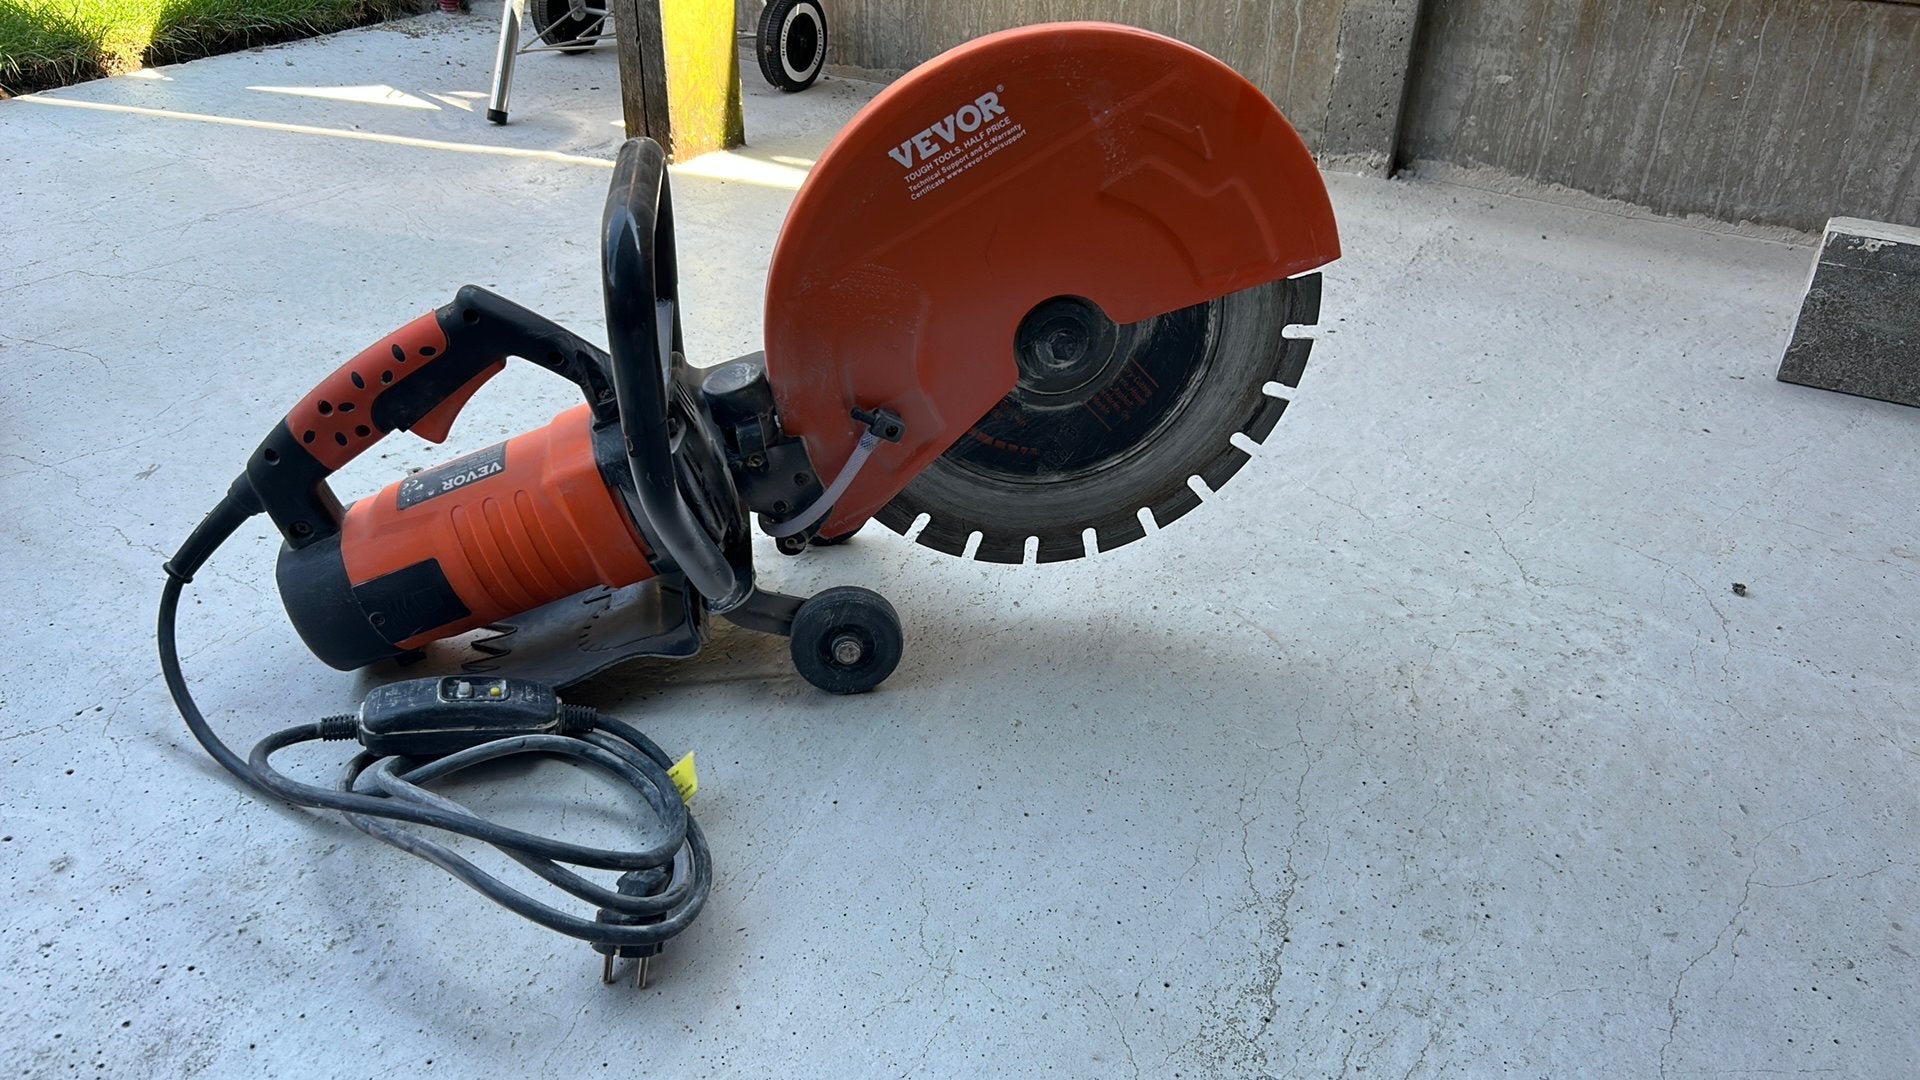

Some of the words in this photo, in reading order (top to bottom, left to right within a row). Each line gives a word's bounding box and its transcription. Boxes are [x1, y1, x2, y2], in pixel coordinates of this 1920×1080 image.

[888, 91, 1006, 169] VEVOR
[904, 162, 934, 183] TOUGH
[933, 146, 964, 166] TOOLS,
[963, 132, 985, 149] HALF
[986, 116, 1011, 136] PRICE
[908, 171, 941, 193] Technical
[941, 155, 969, 174] Support
[969, 146, 983, 158] and
[984, 123, 1022, 149] E-Warranty
[910, 177, 945, 201] Certificate
[442, 461, 502, 491] VEVOR
